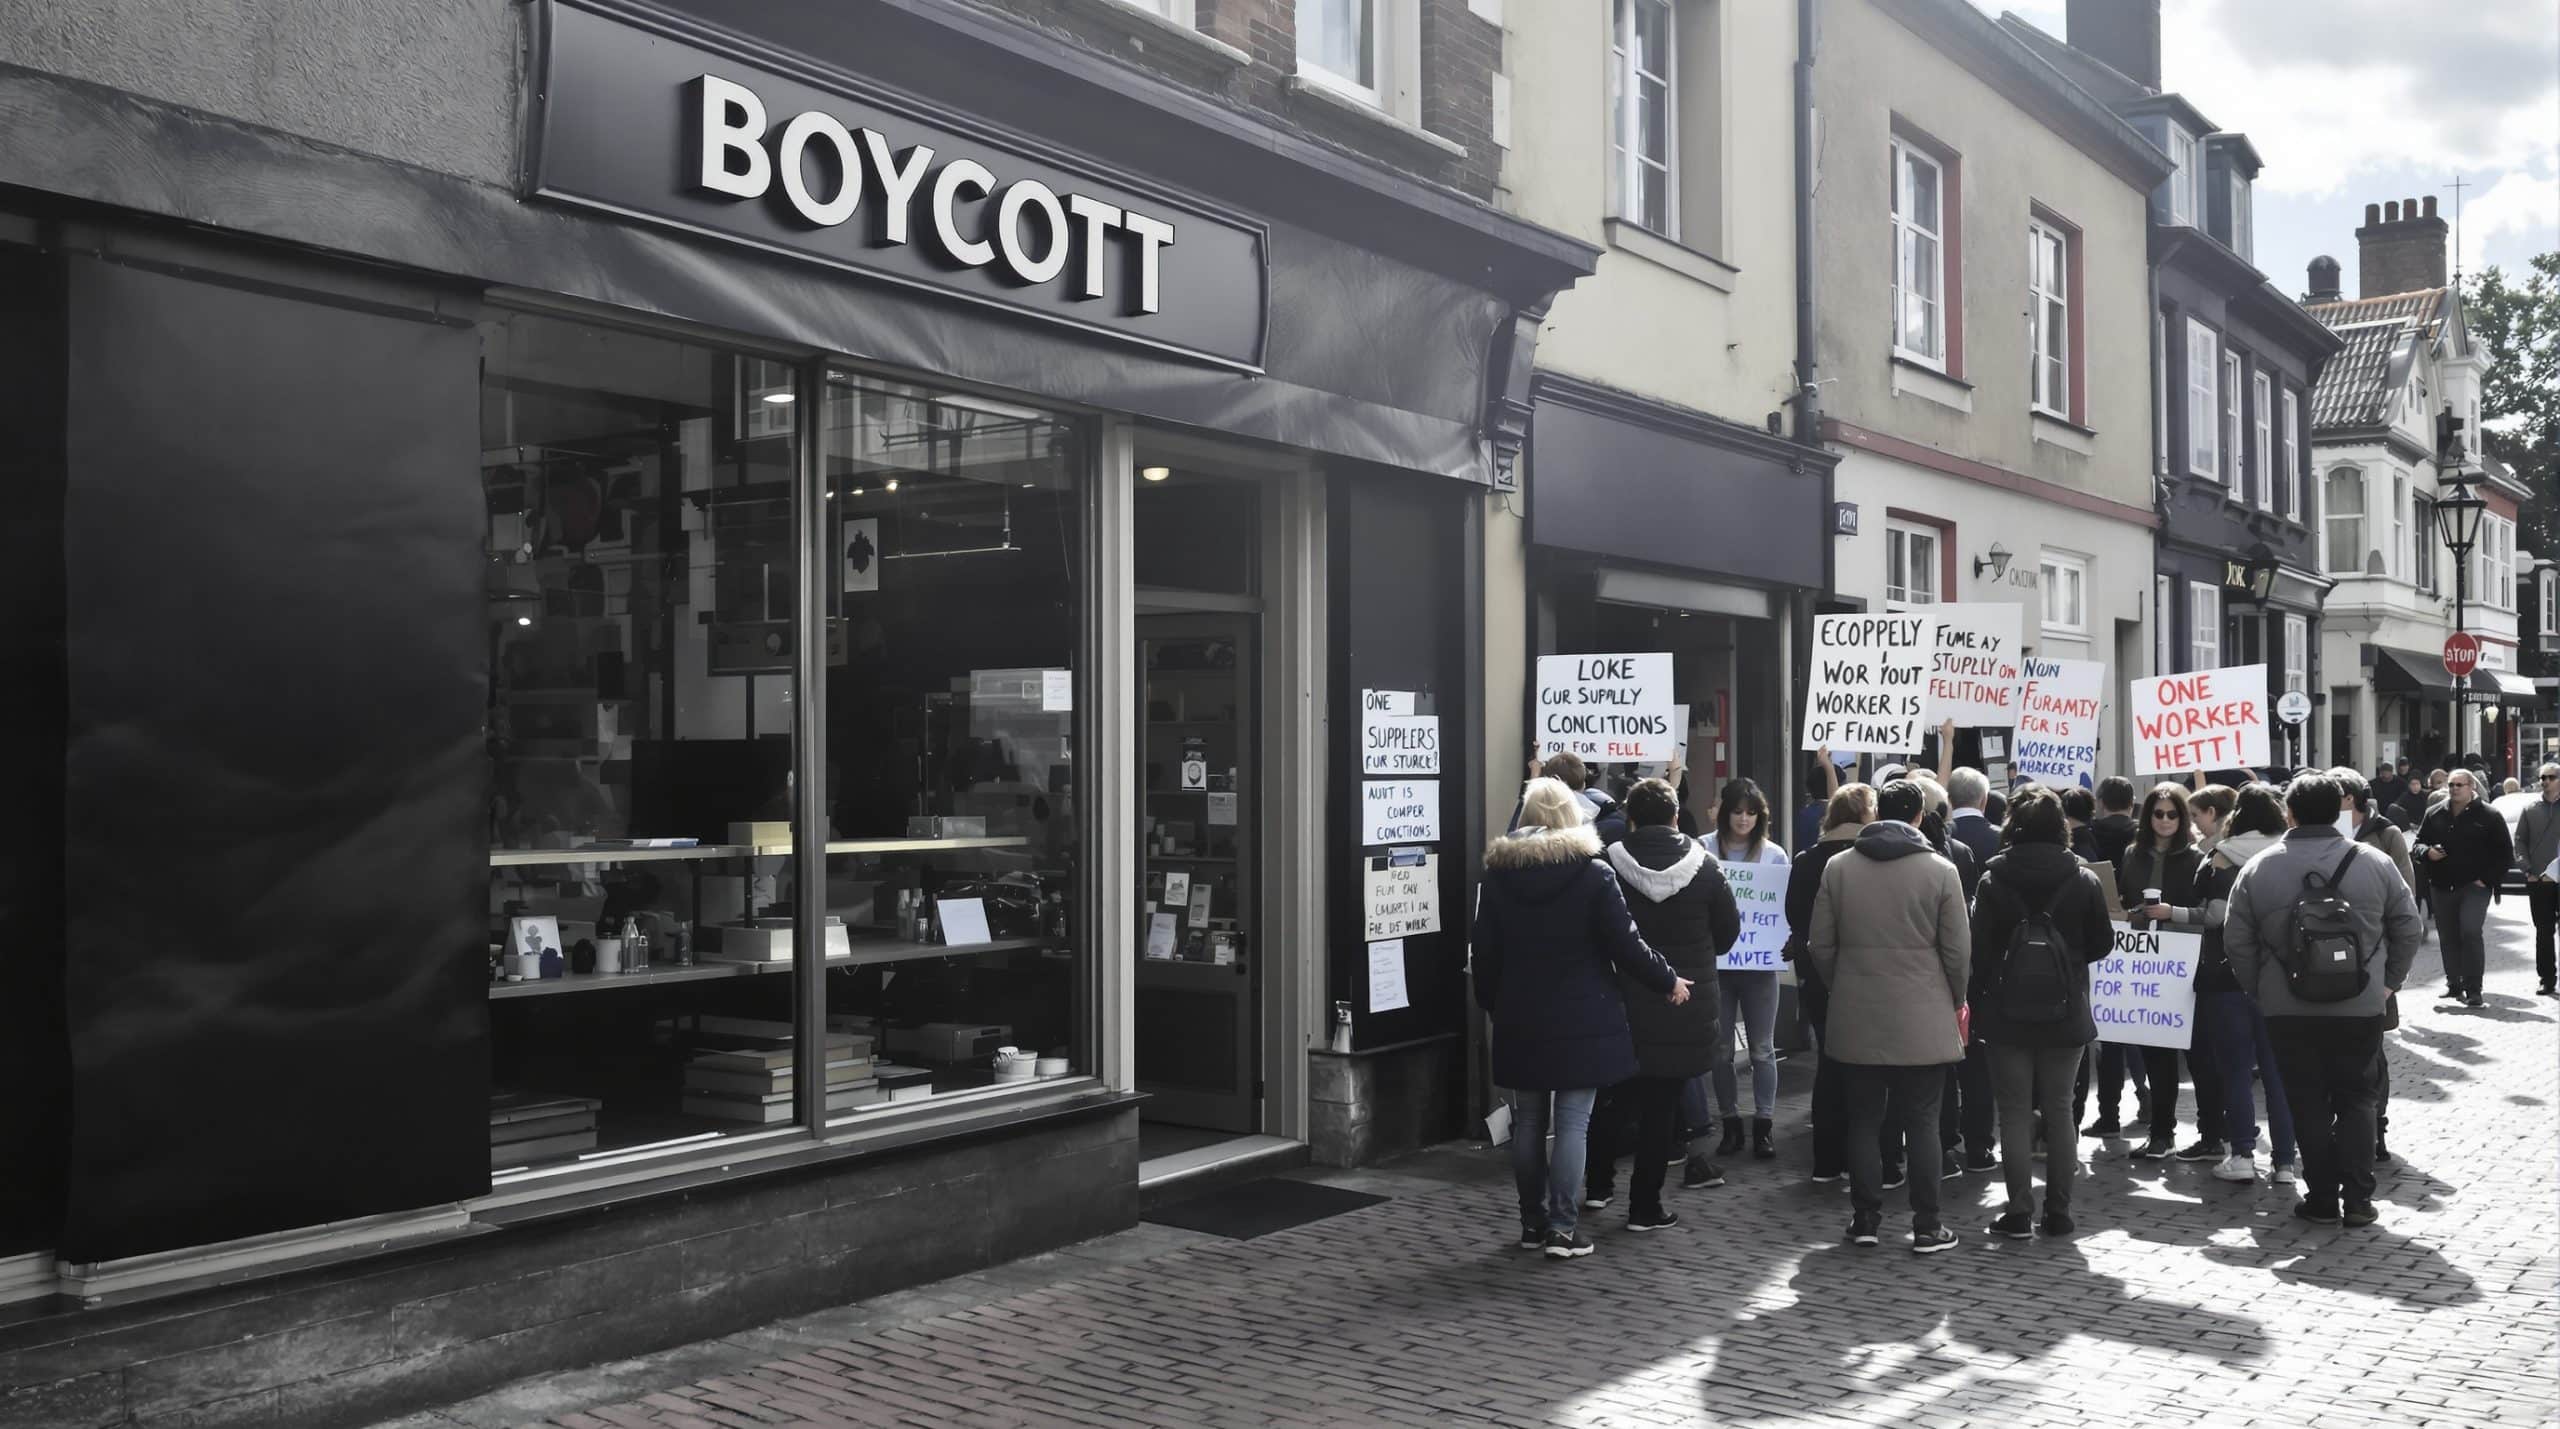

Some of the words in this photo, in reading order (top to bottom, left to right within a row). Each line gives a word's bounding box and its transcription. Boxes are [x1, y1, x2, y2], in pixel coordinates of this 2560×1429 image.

[699, 73, 1175, 314] BOYCOTT
[1577, 658, 1636, 681] LOKE
[1823, 659, 1870, 686] WOR
[1366, 693, 1392, 711] ONE
[1816, 690, 1892, 715] WORKER
[1902, 695, 1921, 716] IS
[1928, 678, 2010, 706] FELITONE
[2157, 674, 2214, 706] ONE
[1547, 713, 1668, 735] CONCITIONS
[1811, 721, 1837, 742] OF
[1845, 719, 1914, 748] FIANS!
[2135, 701, 2261, 740] WORKER
[2094, 980, 2122, 997] FOR
[2130, 982, 2161, 998] THE
[2093, 1004, 2184, 1028] COLLCTIONS
